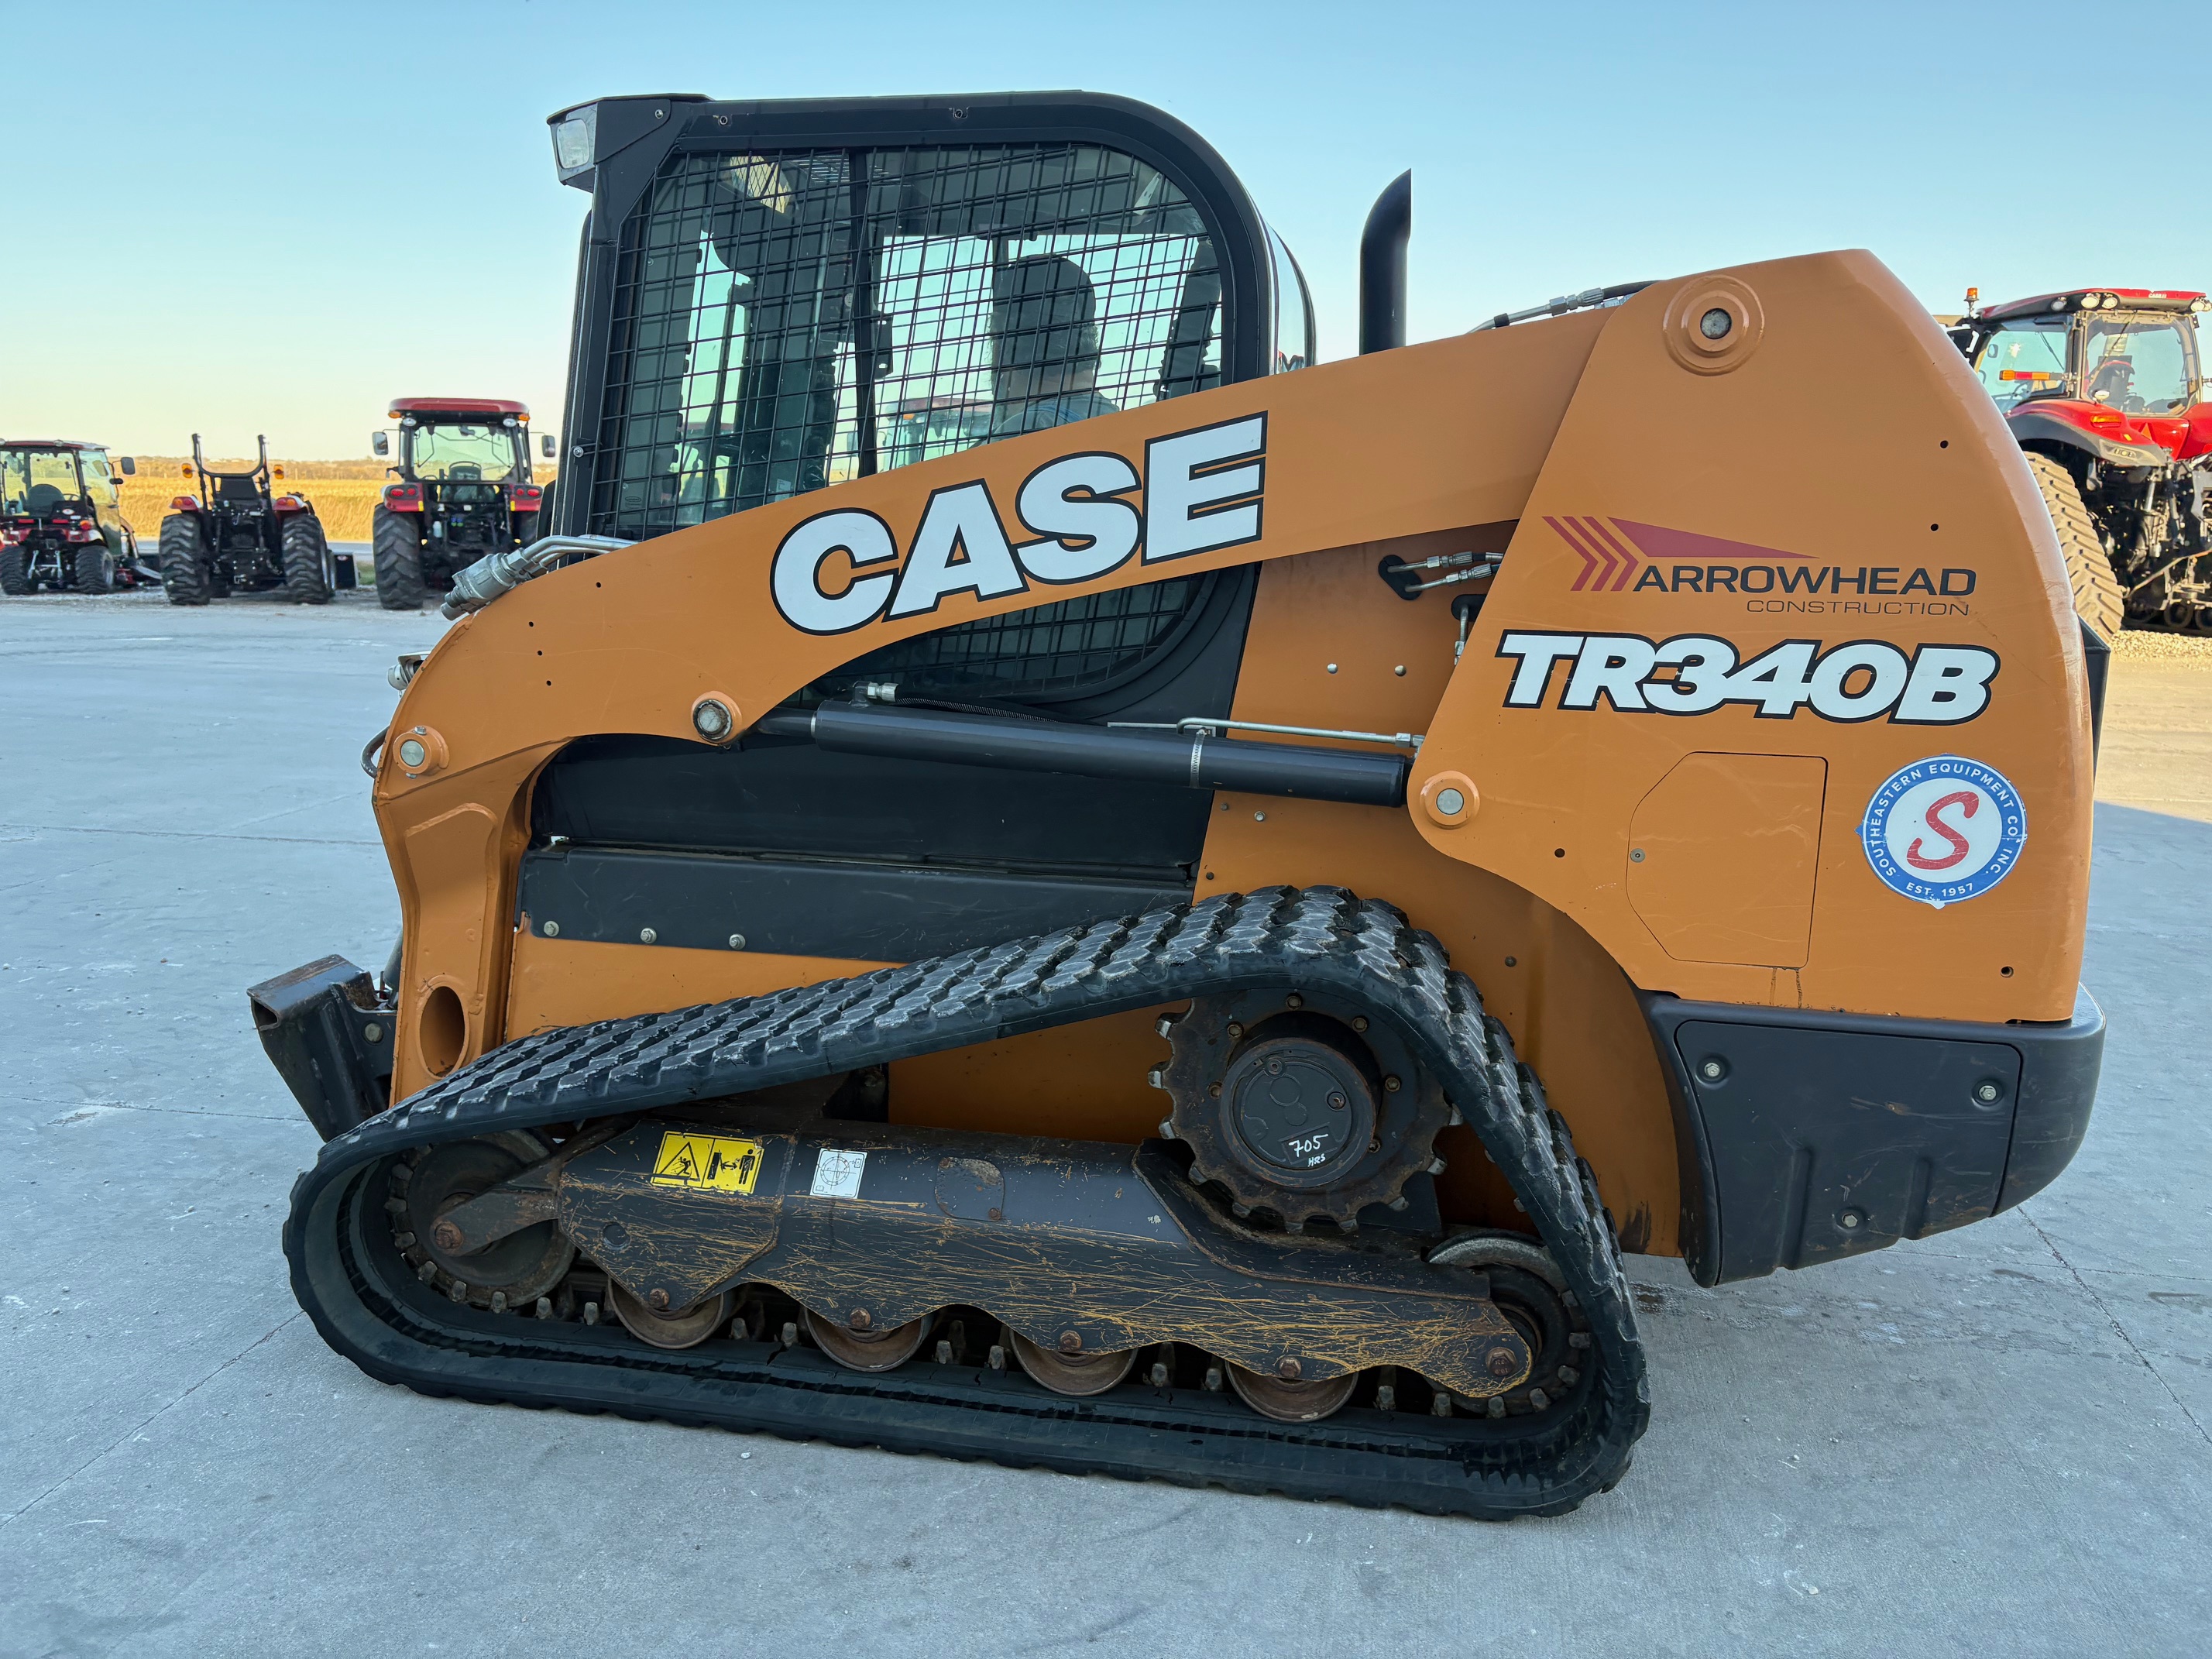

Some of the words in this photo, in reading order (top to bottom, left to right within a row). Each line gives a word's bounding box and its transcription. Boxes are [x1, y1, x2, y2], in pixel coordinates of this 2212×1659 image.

[770, 410, 1269, 636] CASE
[1633, 565, 1977, 596] ARROWHEAD
[1746, 599, 1969, 617] CONSTRUCTION
[1495, 629, 2001, 726] TR340B
[1870, 768, 1922, 878] SOUTHEASTERN
[1929, 763, 2014, 809] EQUIPMENT
[1985, 847, 2014, 874] INC.
[1906, 791, 1980, 871] S
[1905, 881, 1935, 897] EST.
[1941, 882, 1974, 897] 1957
[1288, 1133, 1329, 1158] 705
[1307, 1152, 1327, 1167] HRS
